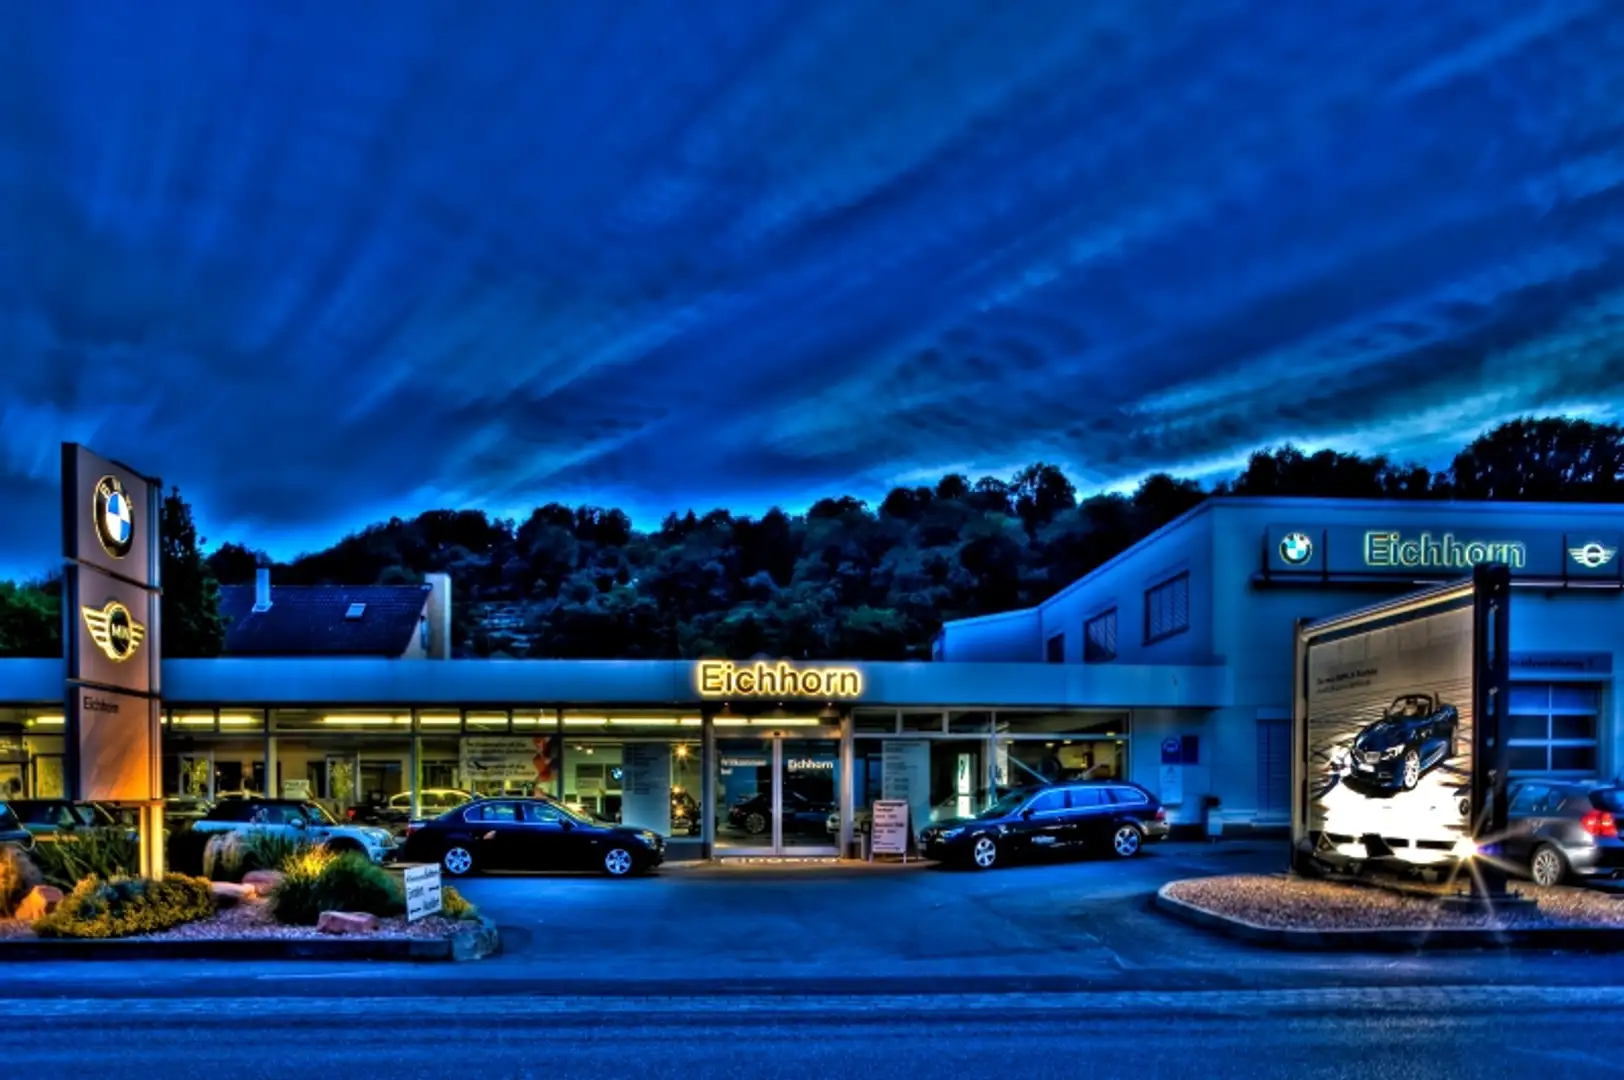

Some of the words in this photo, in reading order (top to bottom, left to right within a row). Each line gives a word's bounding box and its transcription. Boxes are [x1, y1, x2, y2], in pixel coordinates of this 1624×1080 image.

[1365, 531, 1526, 567] Eichhorn
[700, 662, 861, 695] Eichhorn
[787, 758, 834, 769] Eichhorn
